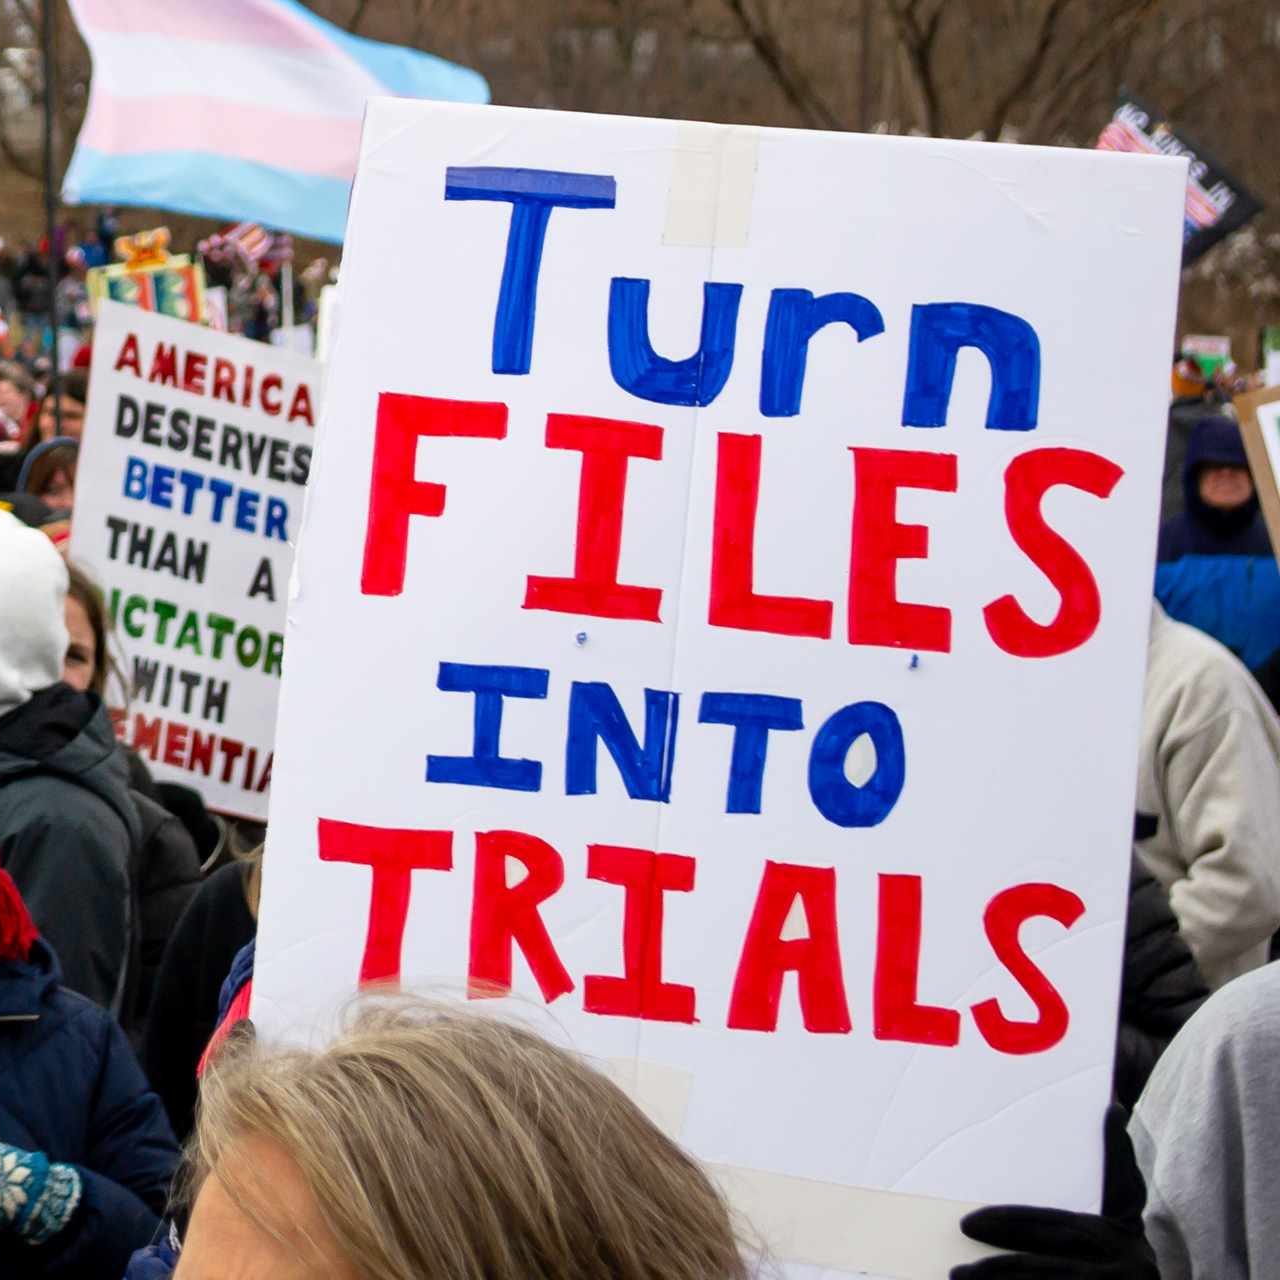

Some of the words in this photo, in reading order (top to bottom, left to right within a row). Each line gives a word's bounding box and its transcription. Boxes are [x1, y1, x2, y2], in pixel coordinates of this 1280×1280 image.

[1113, 102, 1149, 131] NO
[445, 167, 1041, 431] Turn
[114, 332, 315, 426] AMERICA
[115, 393, 313, 486] DESERVES
[123, 455, 289, 542] BETTER
[361, 392, 1124, 658] FILES
[107, 515, 209, 584] THAN
[248, 556, 276, 602] A
[99, 587, 284, 678] ICTATOR
[131, 655, 230, 724] WITH
[425, 662, 905, 828] INTO
[317, 818, 1085, 1054] TRIALS
